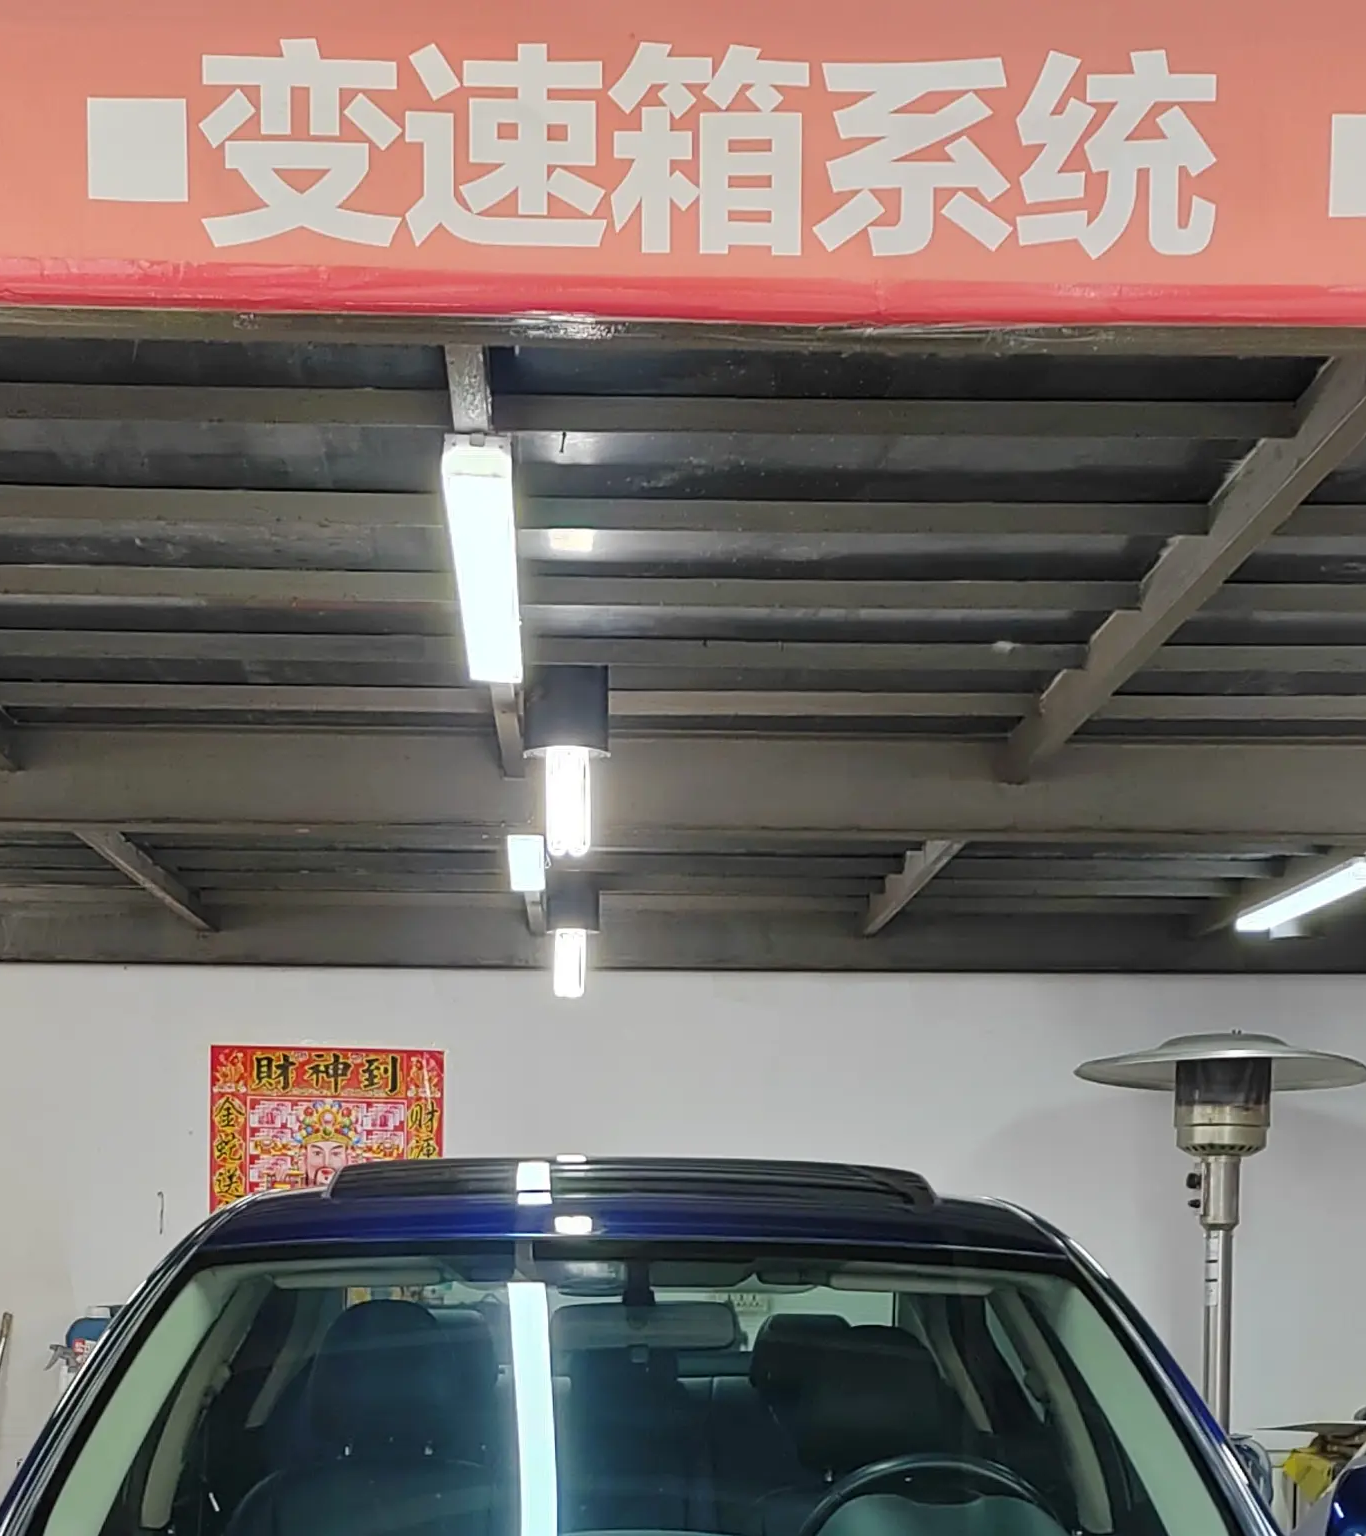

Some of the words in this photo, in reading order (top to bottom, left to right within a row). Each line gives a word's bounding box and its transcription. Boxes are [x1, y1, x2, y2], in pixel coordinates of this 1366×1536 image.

[199, 38, 1219, 261] 变速箱系统
[252, 1053, 400, 1095] 財神到
